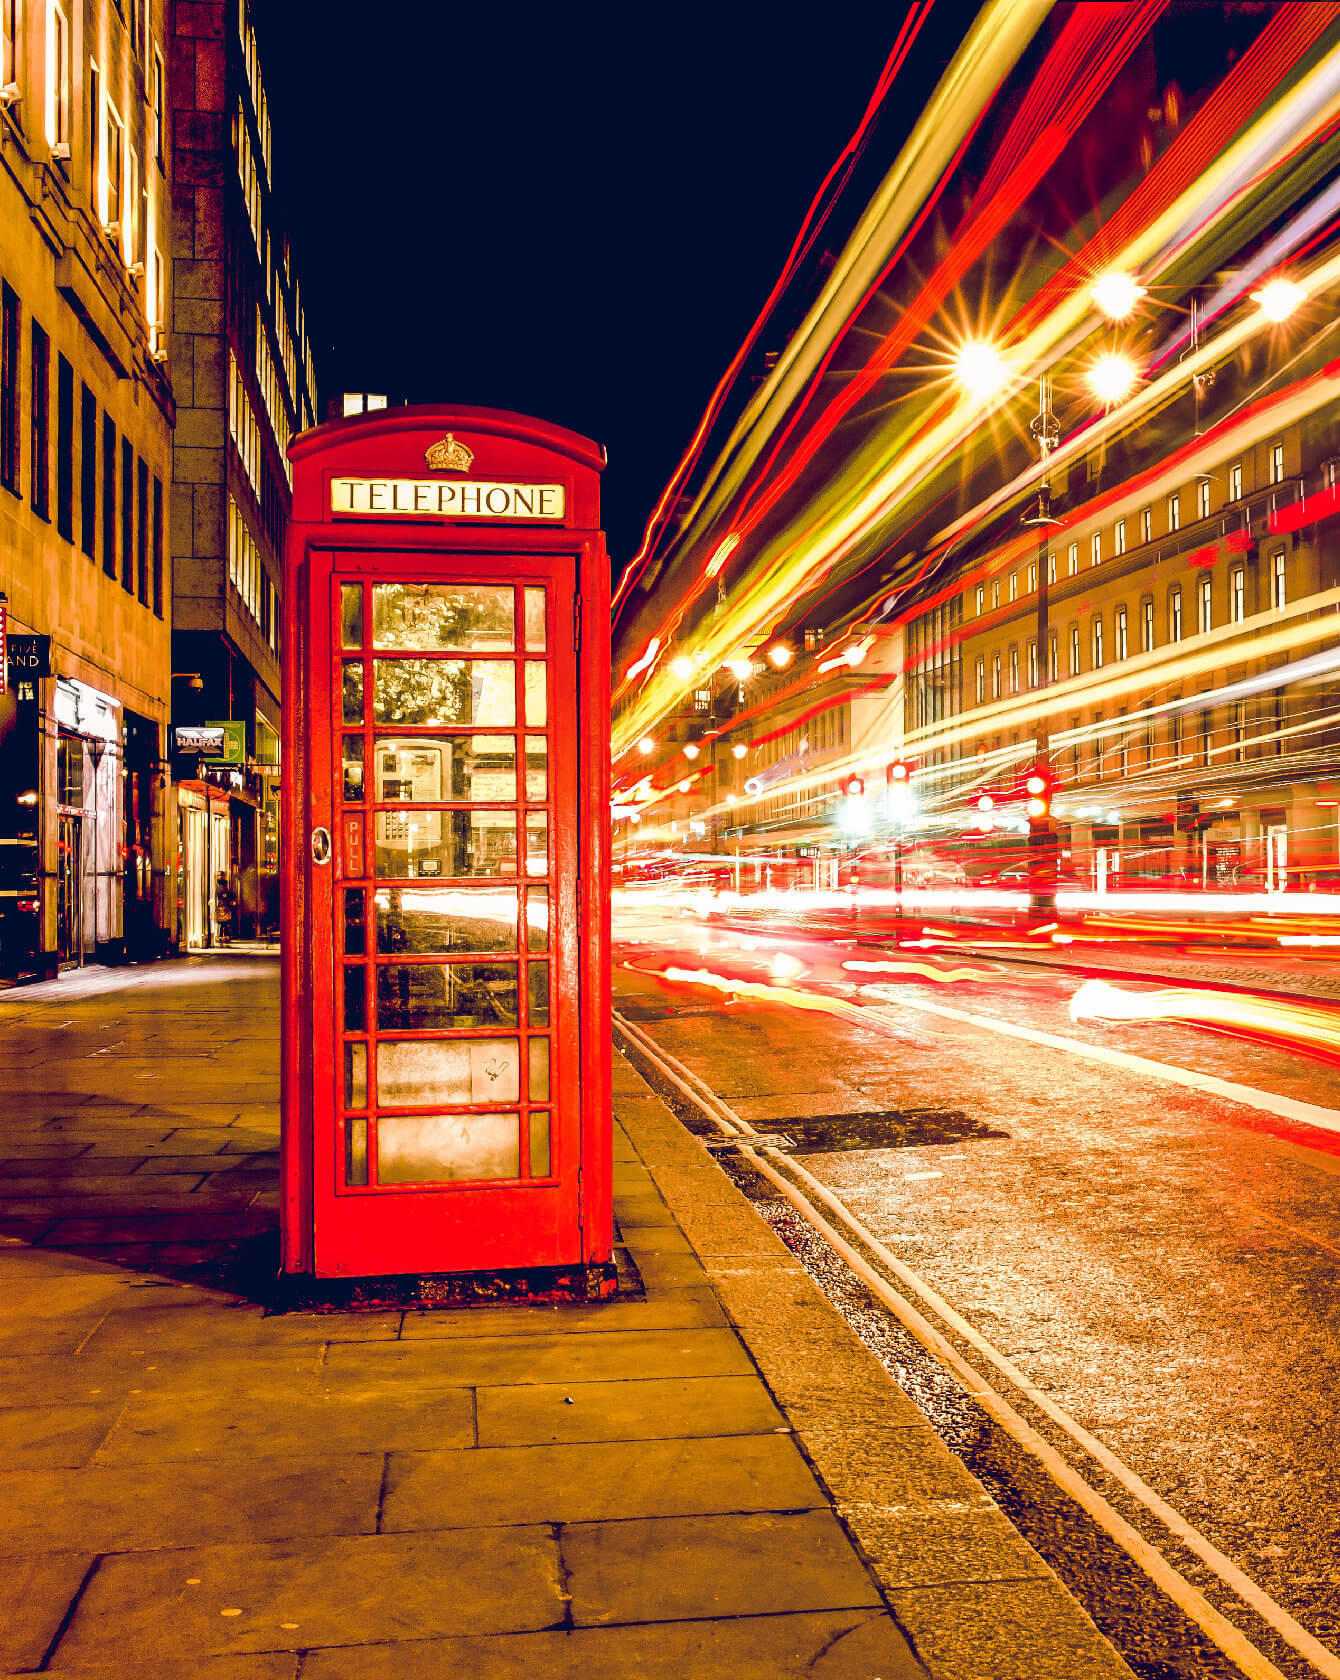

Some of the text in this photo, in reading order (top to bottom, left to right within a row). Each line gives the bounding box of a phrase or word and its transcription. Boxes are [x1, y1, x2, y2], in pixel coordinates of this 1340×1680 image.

[341, 482, 556, 515] TELEPHONE
[176, 738, 222, 747] HALIFAX
[350, 822, 359, 870] PULL
